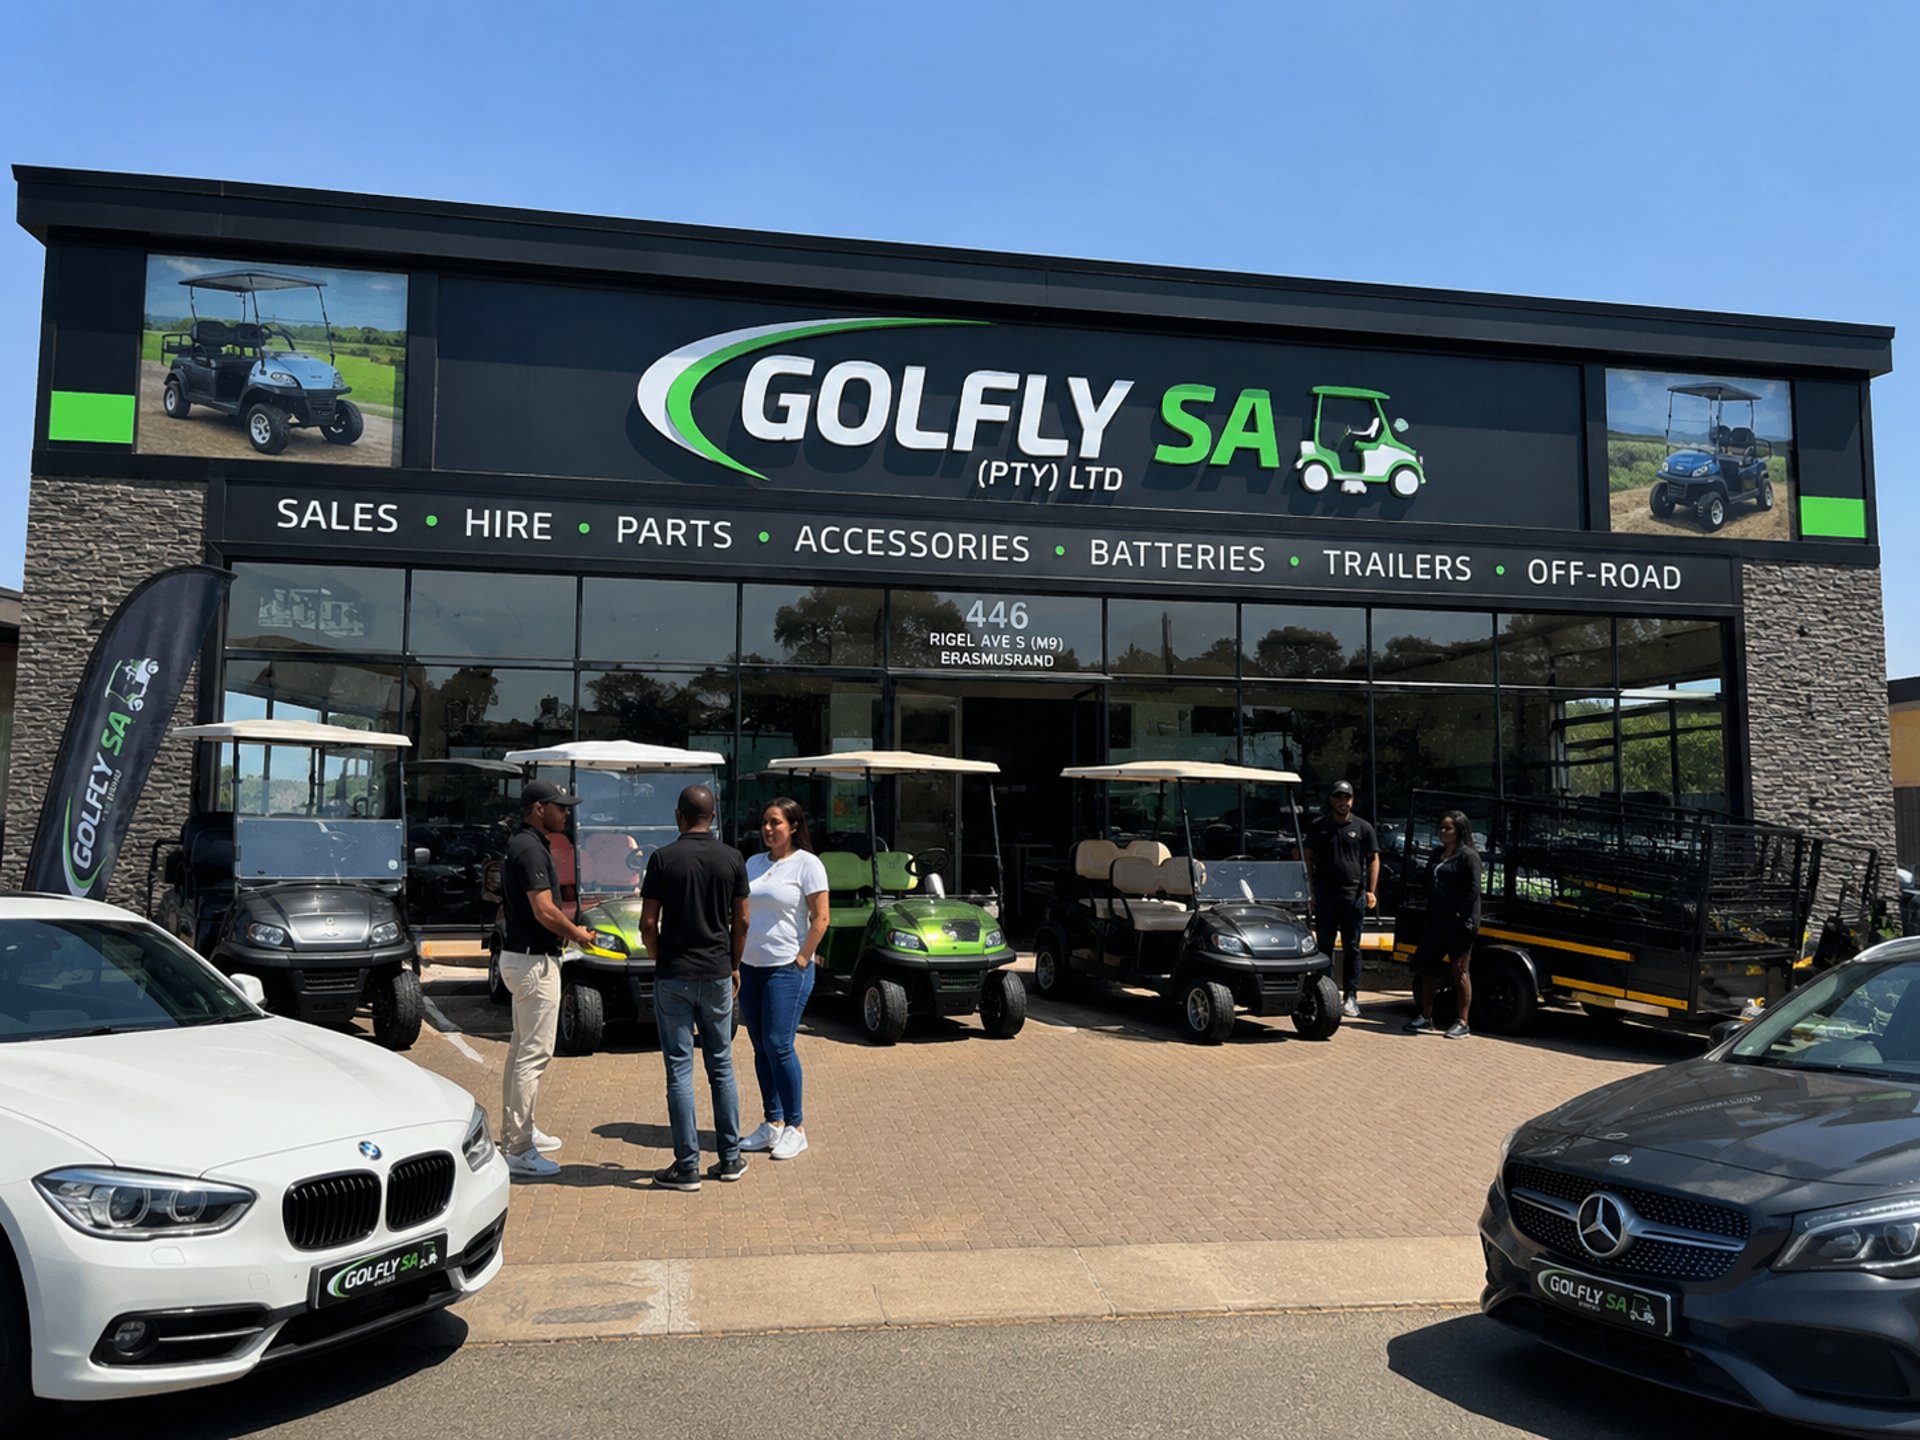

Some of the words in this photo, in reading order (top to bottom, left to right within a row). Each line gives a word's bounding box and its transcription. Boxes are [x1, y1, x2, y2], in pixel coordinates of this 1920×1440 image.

[741, 354, 1135, 459] GOLFLY
[1154, 383, 1280, 468] SA
[978, 459, 1059, 492] (PTY)
[1069, 465, 1123, 491] LTD
[277, 498, 398, 533] SALES
[465, 508, 553, 541] HIRE
[617, 515, 732, 549] PARTS
[794, 525, 1030, 562] ACCESSORIES
[1090, 539, 1266, 573] BATTERIES
[1322, 549, 1472, 581] TRAILERS
[1528, 558, 1681, 590] OFF-ROAD
[965, 599, 1029, 630] 446
[929, 632, 975, 647] RIGEL
[980, 634, 1011, 648] AVE
[1016, 635, 1026, 649] S
[1030, 636, 1064, 652] (M9)
[940, 651, 1054, 667] ERASMUSRAND
[101, 711, 132, 756] SA
[344, 1257, 400, 1289] GOLFLY
[400, 1252, 418, 1272] SA
[1550, 1275, 1604, 1305] GOLFLY
[1605, 1293, 1628, 1314] SA
